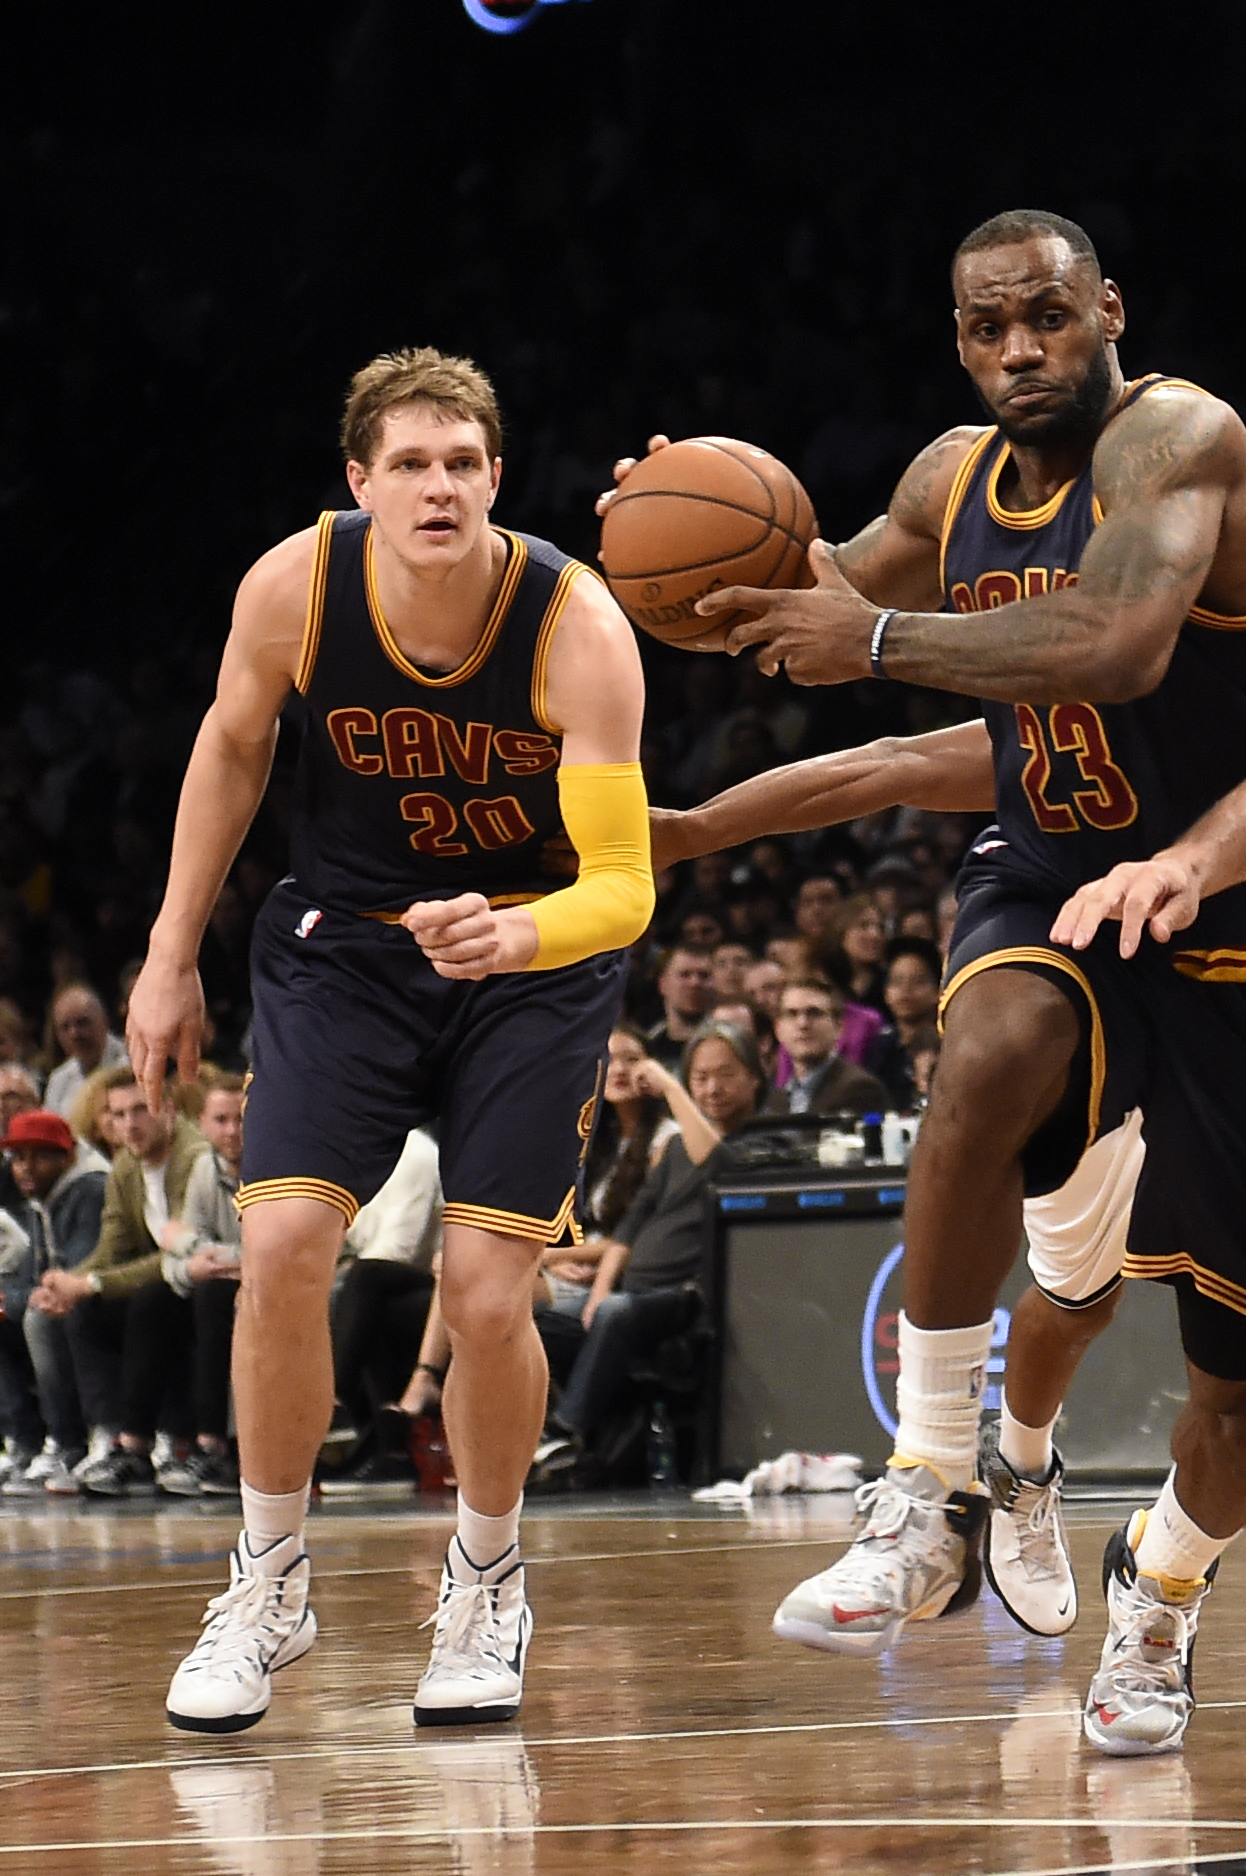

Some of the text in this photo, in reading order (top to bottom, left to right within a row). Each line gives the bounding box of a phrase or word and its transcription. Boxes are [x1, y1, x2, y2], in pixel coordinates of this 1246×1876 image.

[327, 707, 559, 784] CAVS
[1015, 702, 1138, 832] 23
[400, 792, 535, 857] 20
